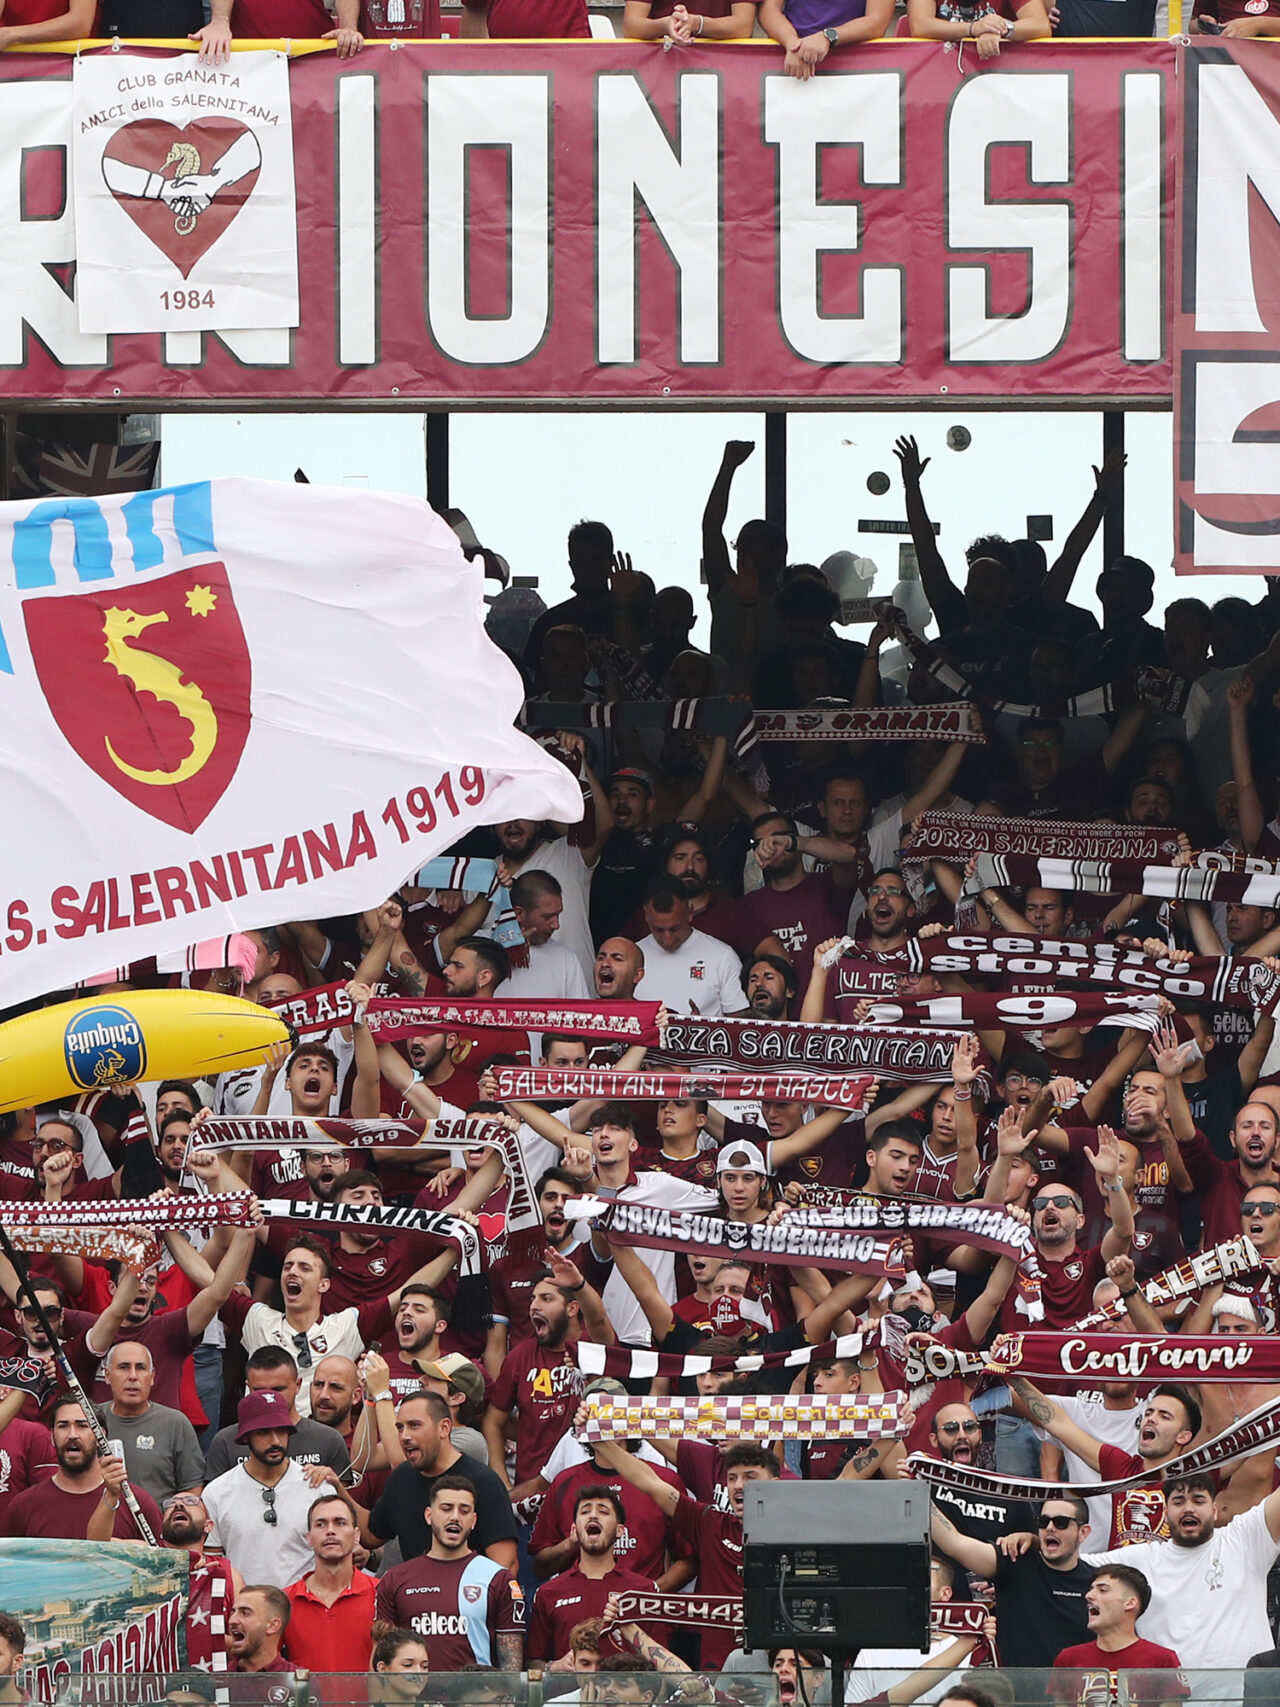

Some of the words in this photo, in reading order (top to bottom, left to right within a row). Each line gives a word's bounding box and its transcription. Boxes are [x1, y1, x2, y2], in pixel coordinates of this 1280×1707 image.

[117, 74, 157, 93] CLUB
[164, 69, 241, 89] GRANATA
[80, 104, 126, 134] AMICI
[131, 96, 164, 112] della
[171, 94, 280, 126] SALERNITANA
[159, 289, 216, 311] 1984
[51, 811, 381, 939] SALERNITANA
[382, 766, 485, 845] 1919
[910, 827, 990, 850] FORZA
[994, 832, 1158, 859] SALERNITANA
[930, 953, 1206, 997] storico
[67, 1022, 139, 1055] Chiquita
[348, 1129, 400, 1148] 1919
[33, 1207, 169, 1225] SALERNITANA
[173, 1203, 219, 1220] 1919
[907, 1204, 1031, 1248] SIBERIANO
[750, 1223, 875, 1264] SIBERIANO
[1060, 1338, 1253, 1377] Cent'anni
[587, 1403, 680, 1424] Magica
[741, 1402, 893, 1420] Salernitana
[405, 1586, 440, 1595] GIVOVA
